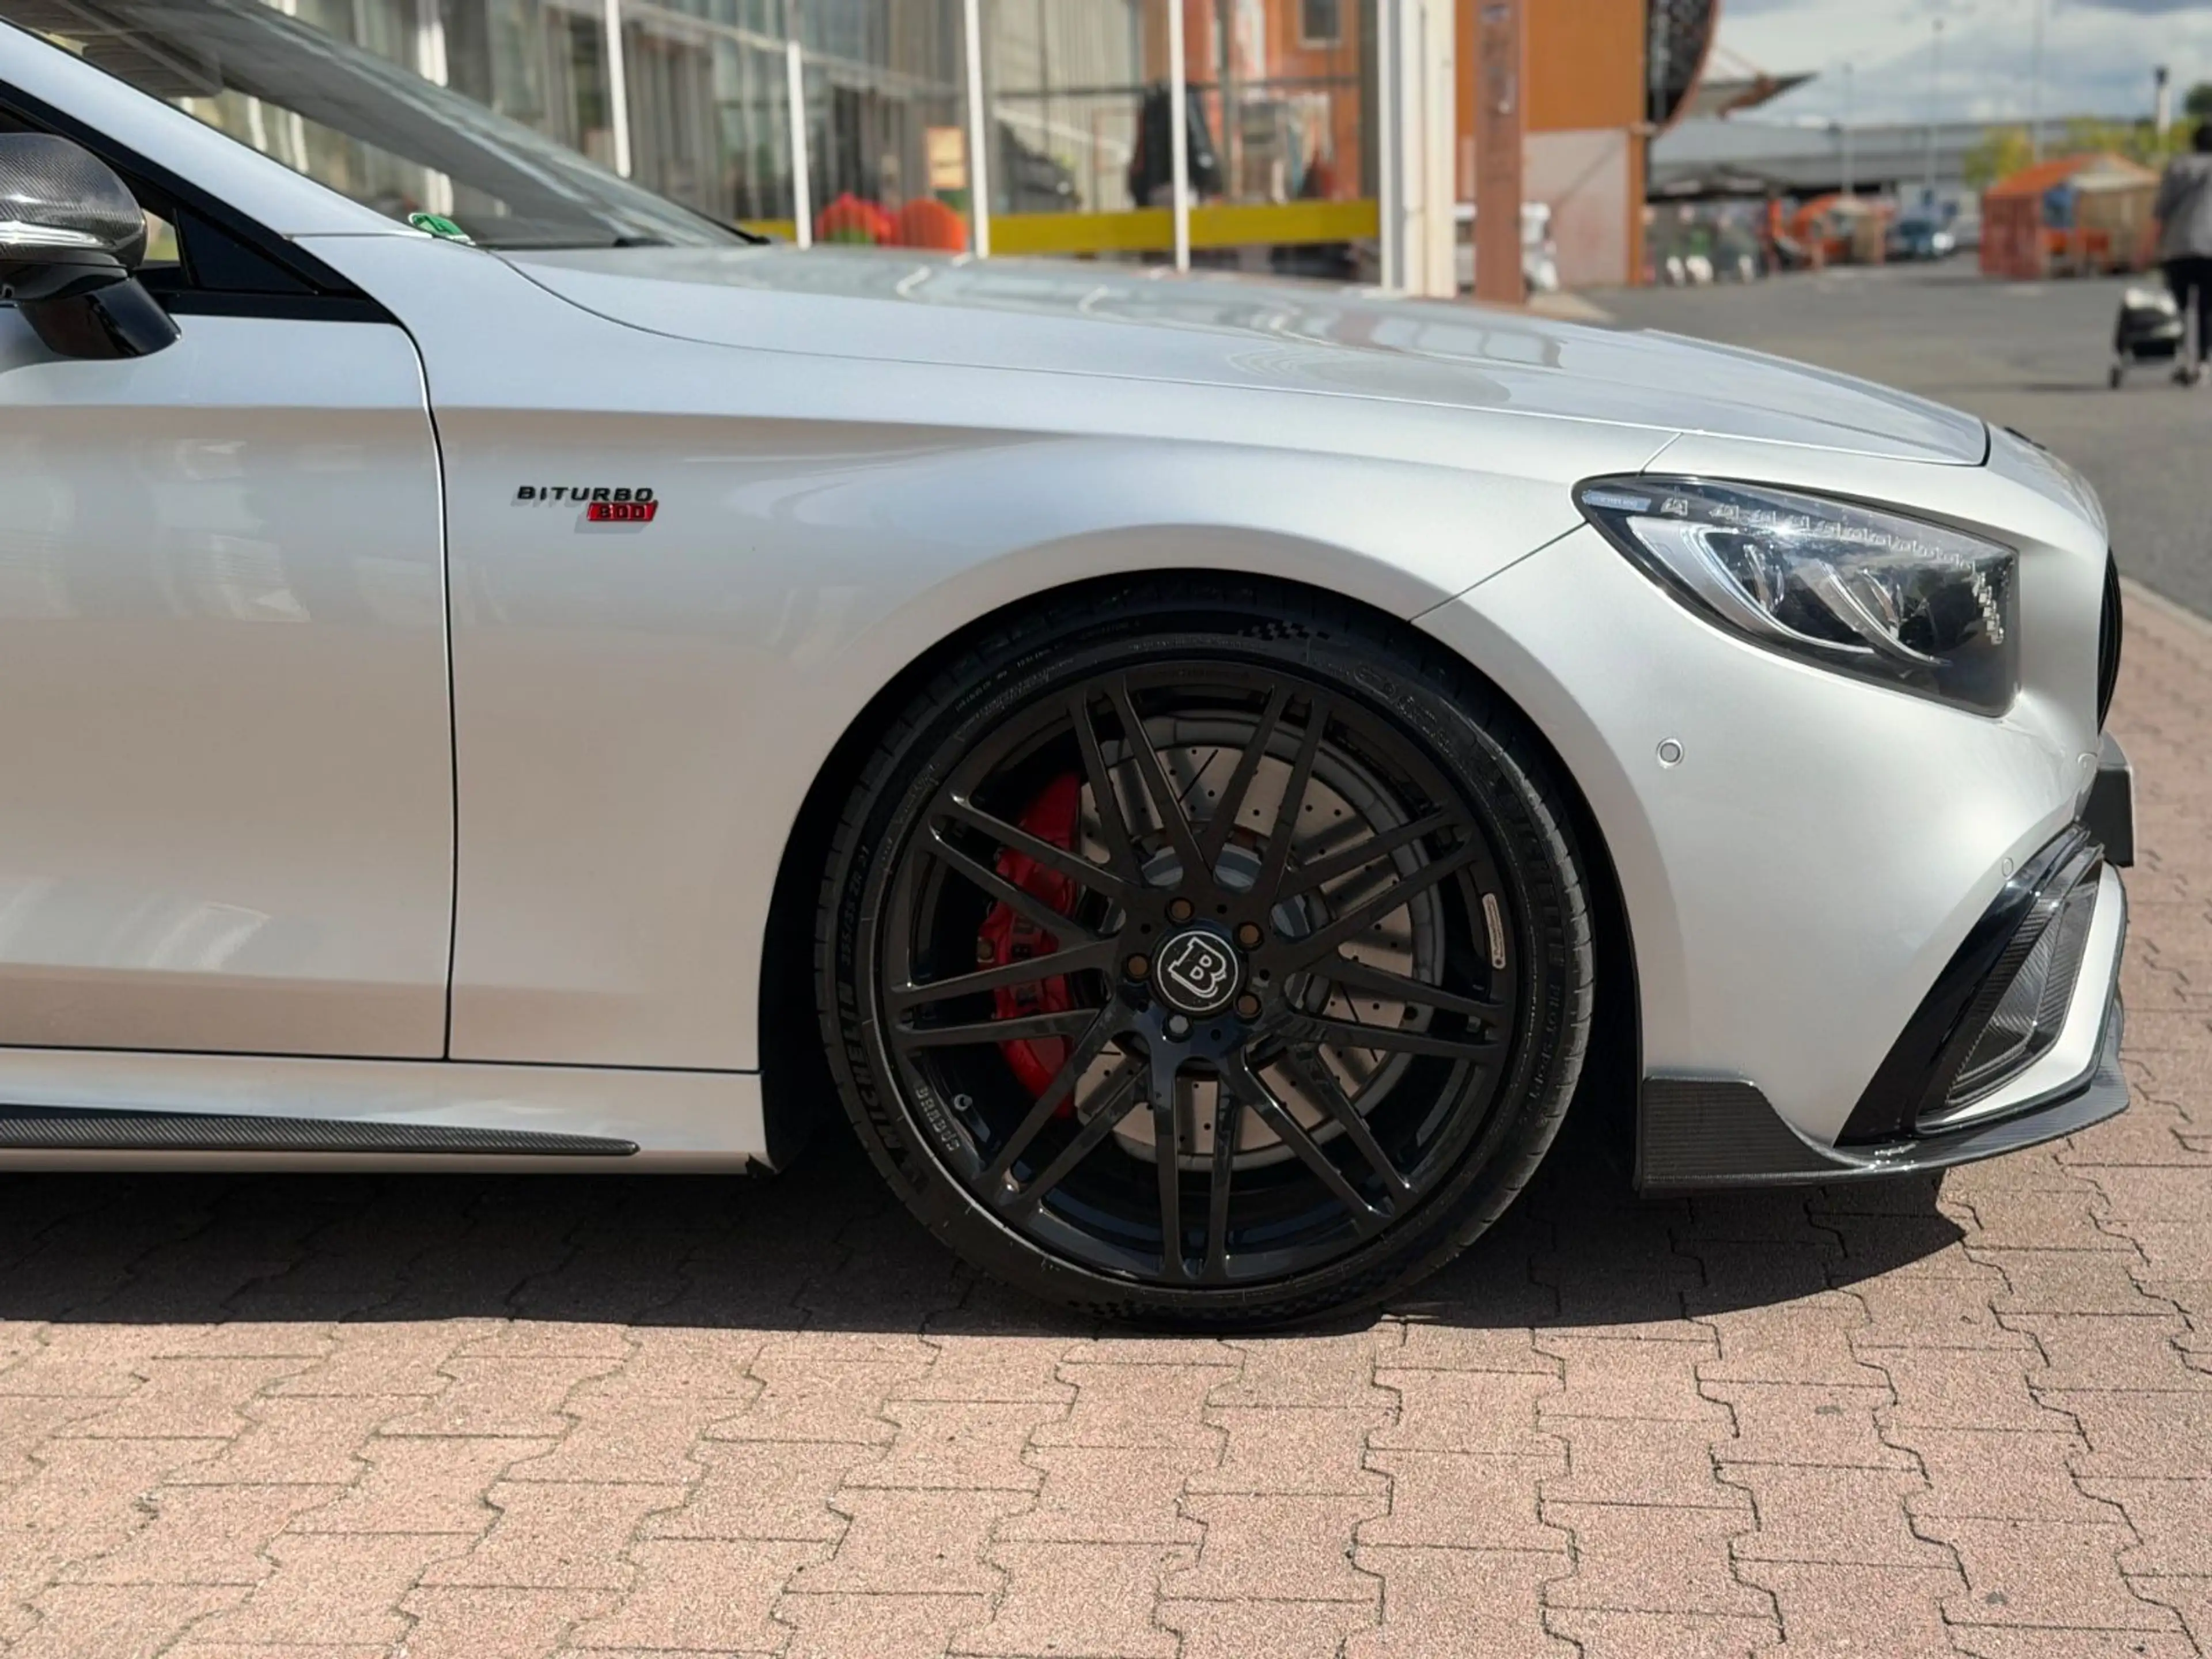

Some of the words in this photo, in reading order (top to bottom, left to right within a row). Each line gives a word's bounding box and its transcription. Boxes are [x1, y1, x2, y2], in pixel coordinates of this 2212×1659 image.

[517, 486, 654, 502] BITURBO
[599, 503, 646, 518] 800
[837, 980, 903, 1149] MICHELIN
[914, 1081, 960, 1152] BRABUS
